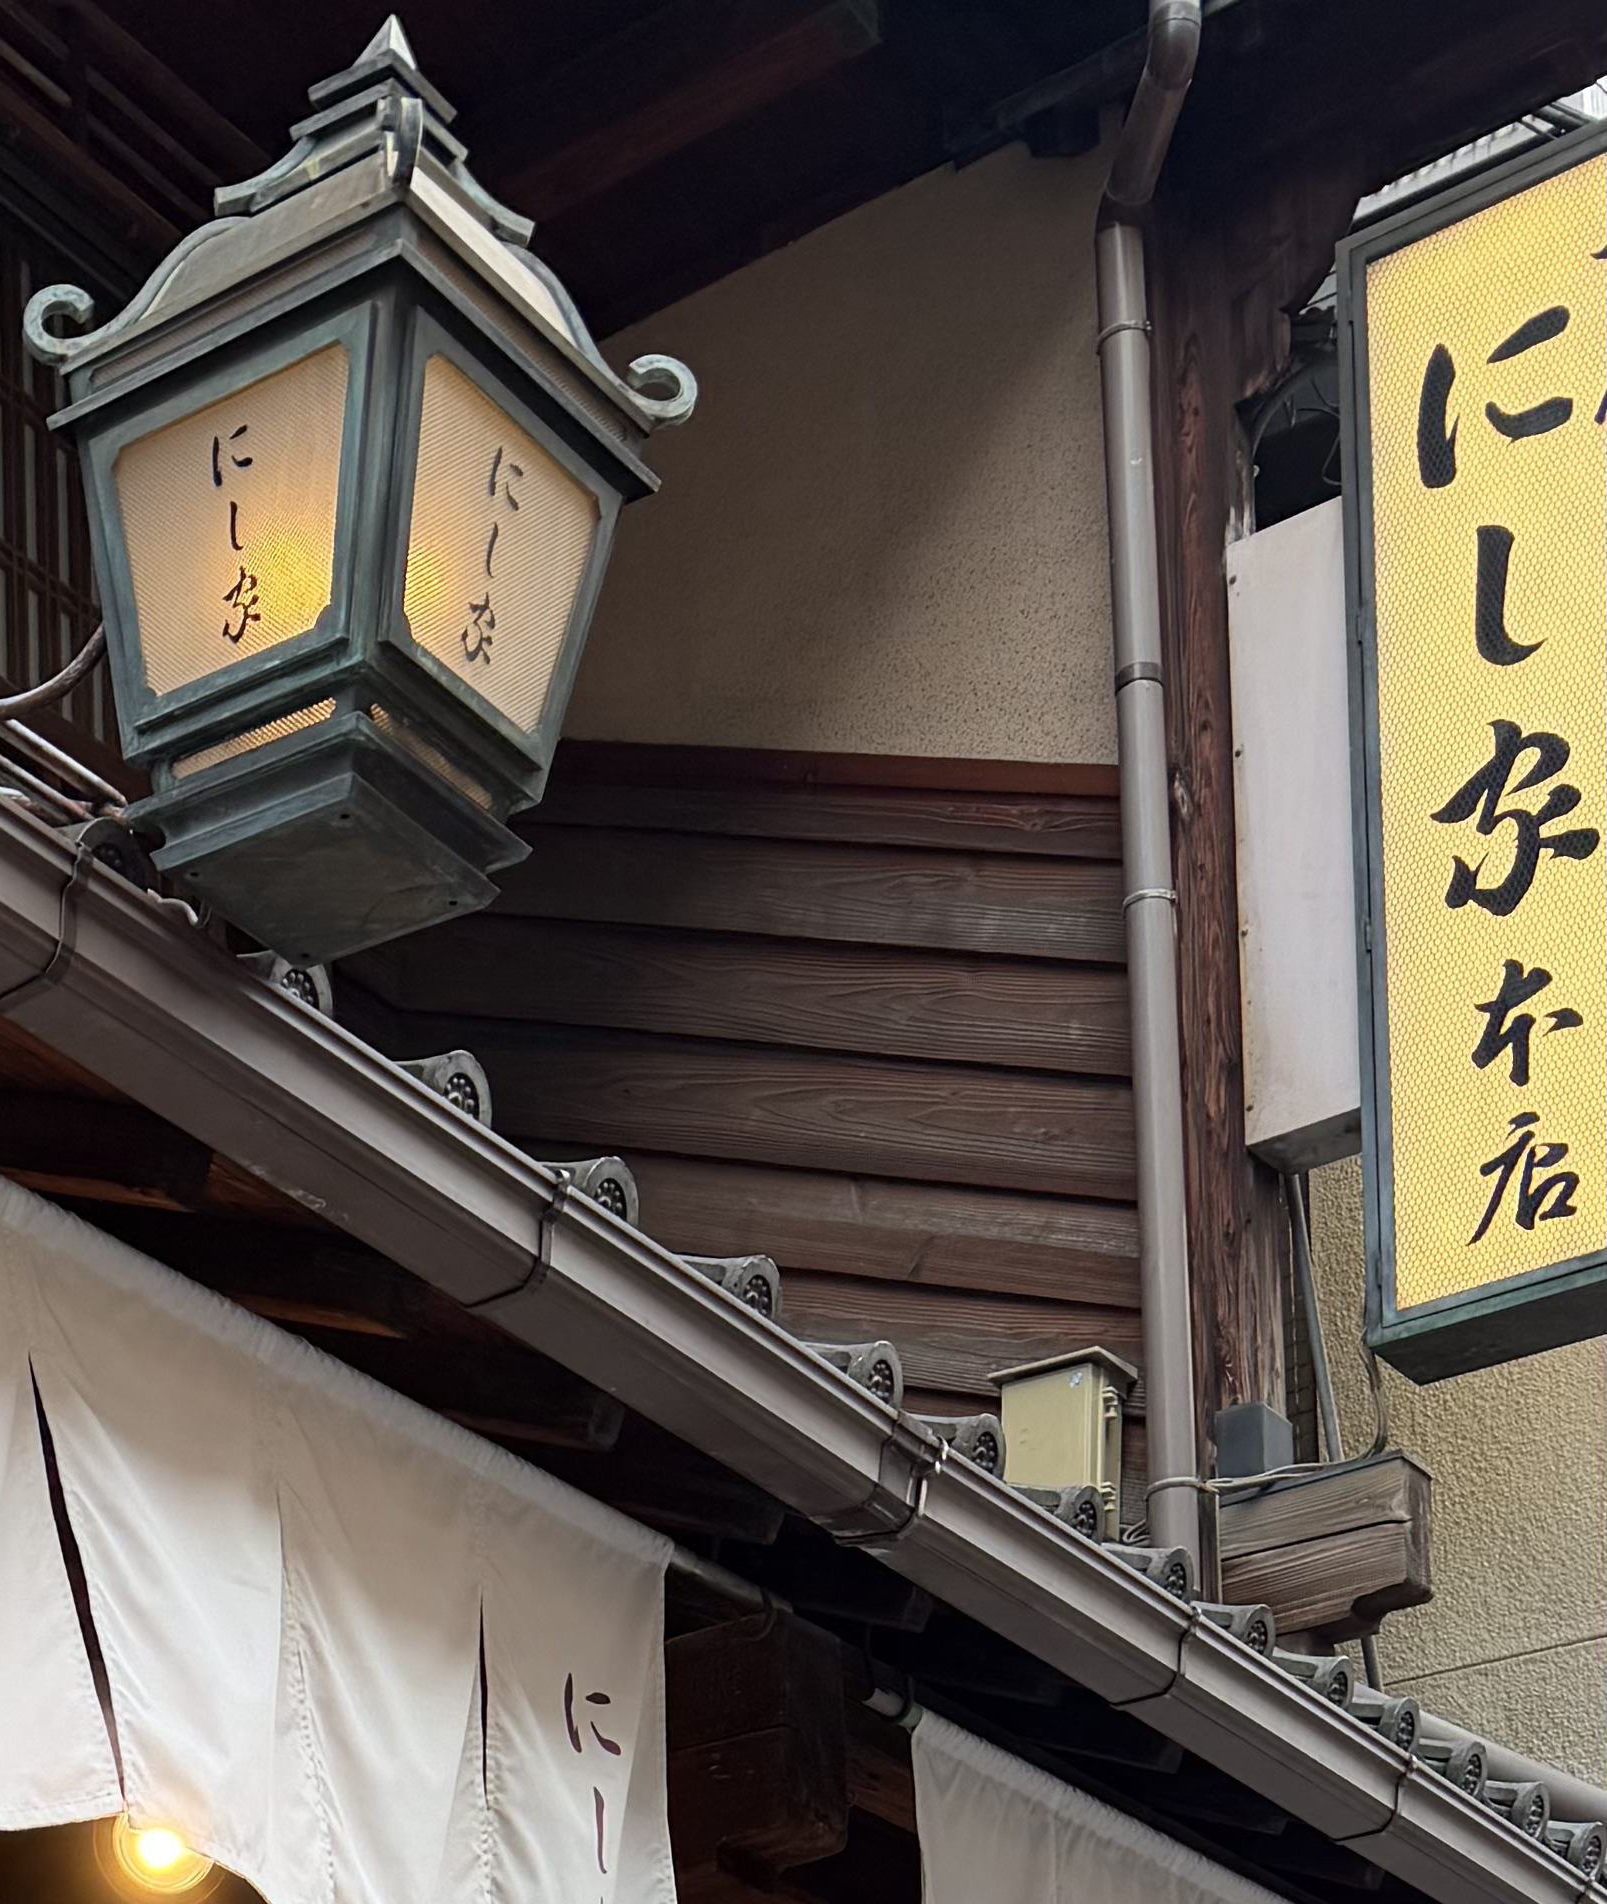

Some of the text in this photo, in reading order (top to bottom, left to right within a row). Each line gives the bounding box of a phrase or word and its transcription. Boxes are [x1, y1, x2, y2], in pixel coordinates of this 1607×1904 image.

[211, 424, 261, 644] にし家
[461, 446, 523, 665] にし家
[1416, 304, 1600, 1247] にし家本店
